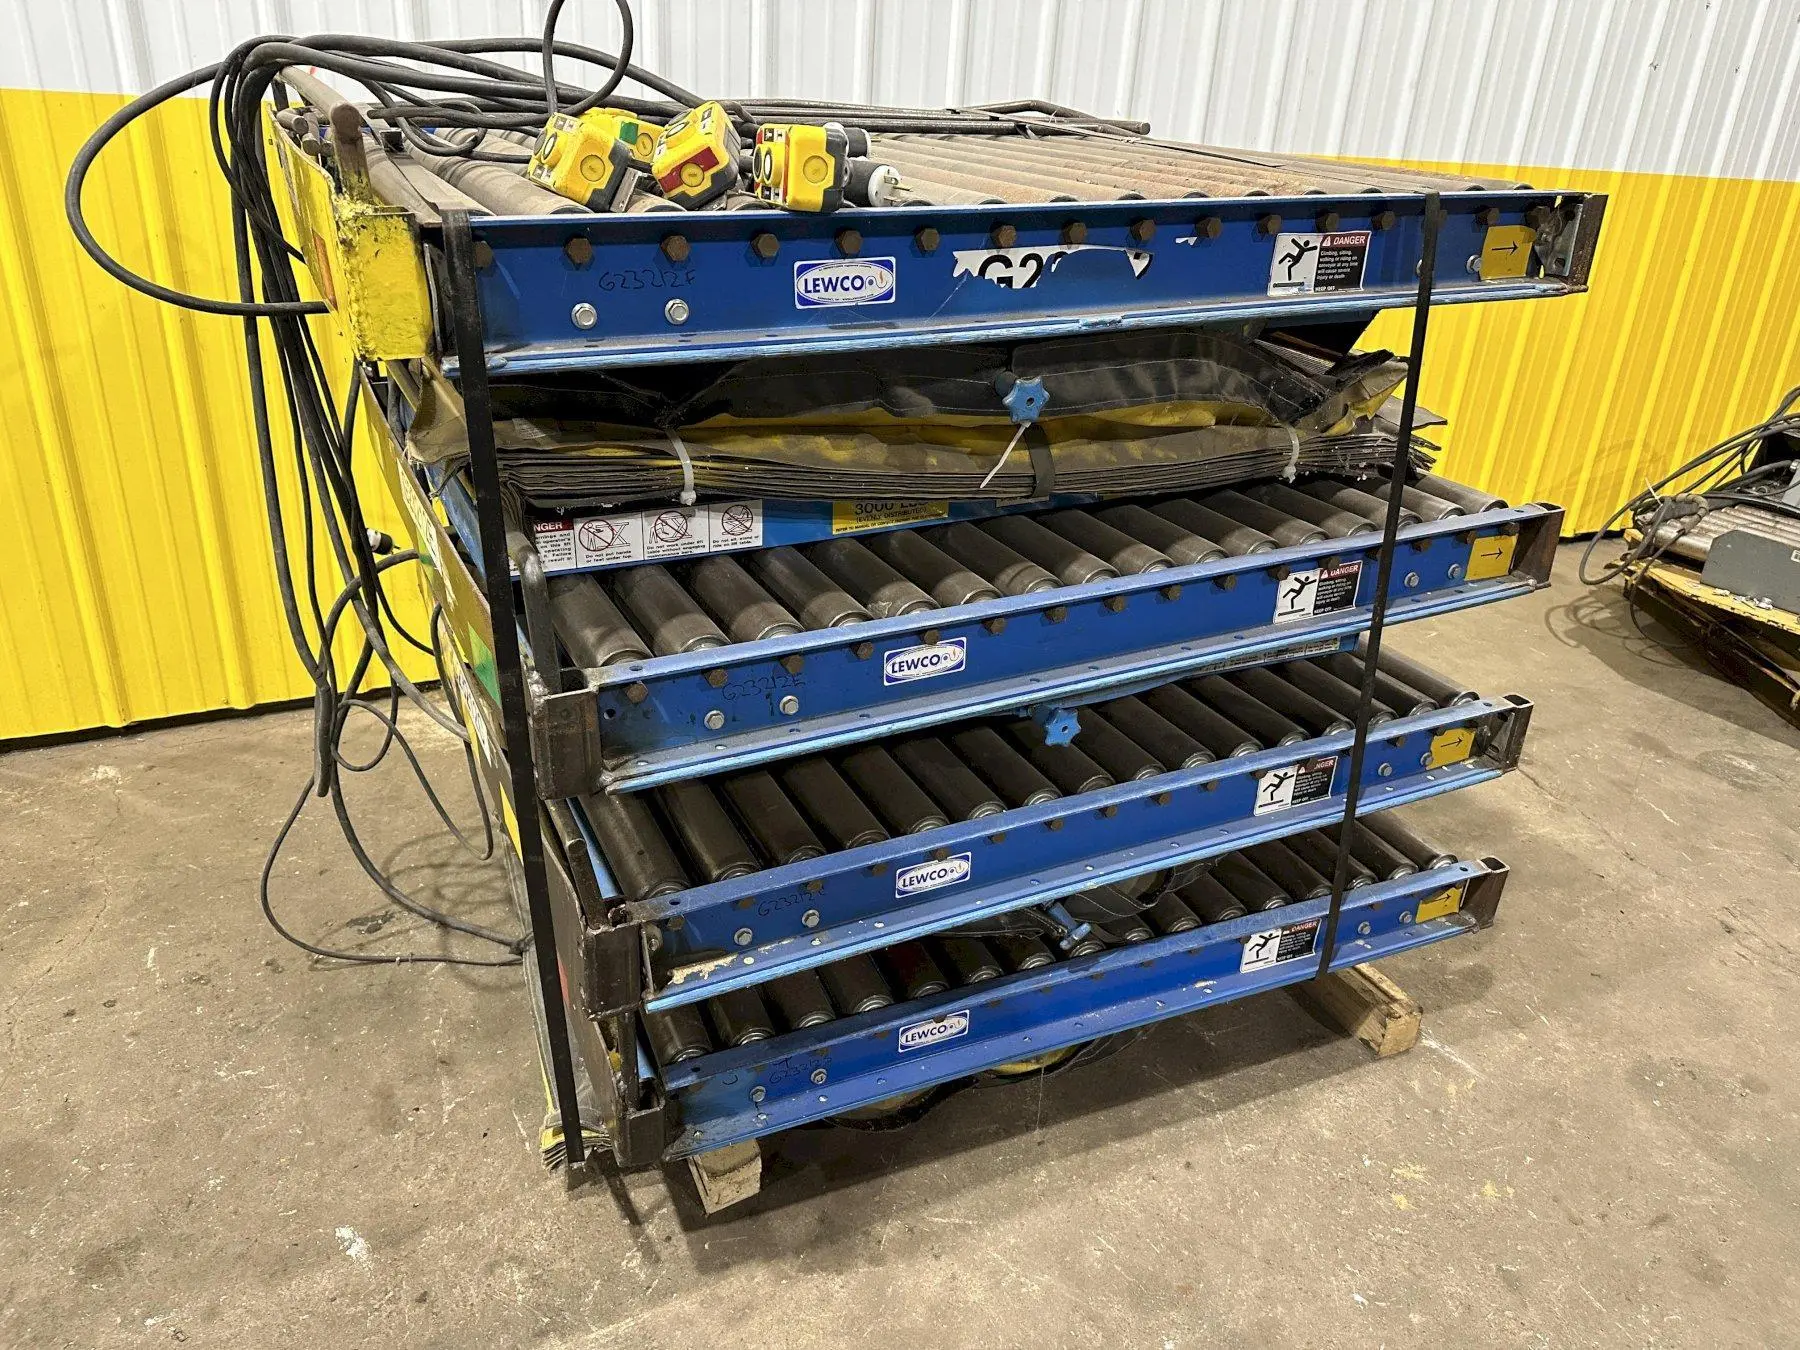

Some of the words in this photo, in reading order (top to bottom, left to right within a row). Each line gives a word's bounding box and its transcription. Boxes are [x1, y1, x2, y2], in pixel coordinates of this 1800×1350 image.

[1333, 236, 1365, 245] DANGER
[804, 275, 864, 293] LEWCO
[534, 522, 563, 532] NGER
[1330, 565, 1359, 577] DANGER
[891, 654, 940, 674] LEWCO
[1314, 759, 1334, 770] NGER
[902, 868, 948, 887] LEWCO
[905, 1025, 947, 1043] LEWCO
